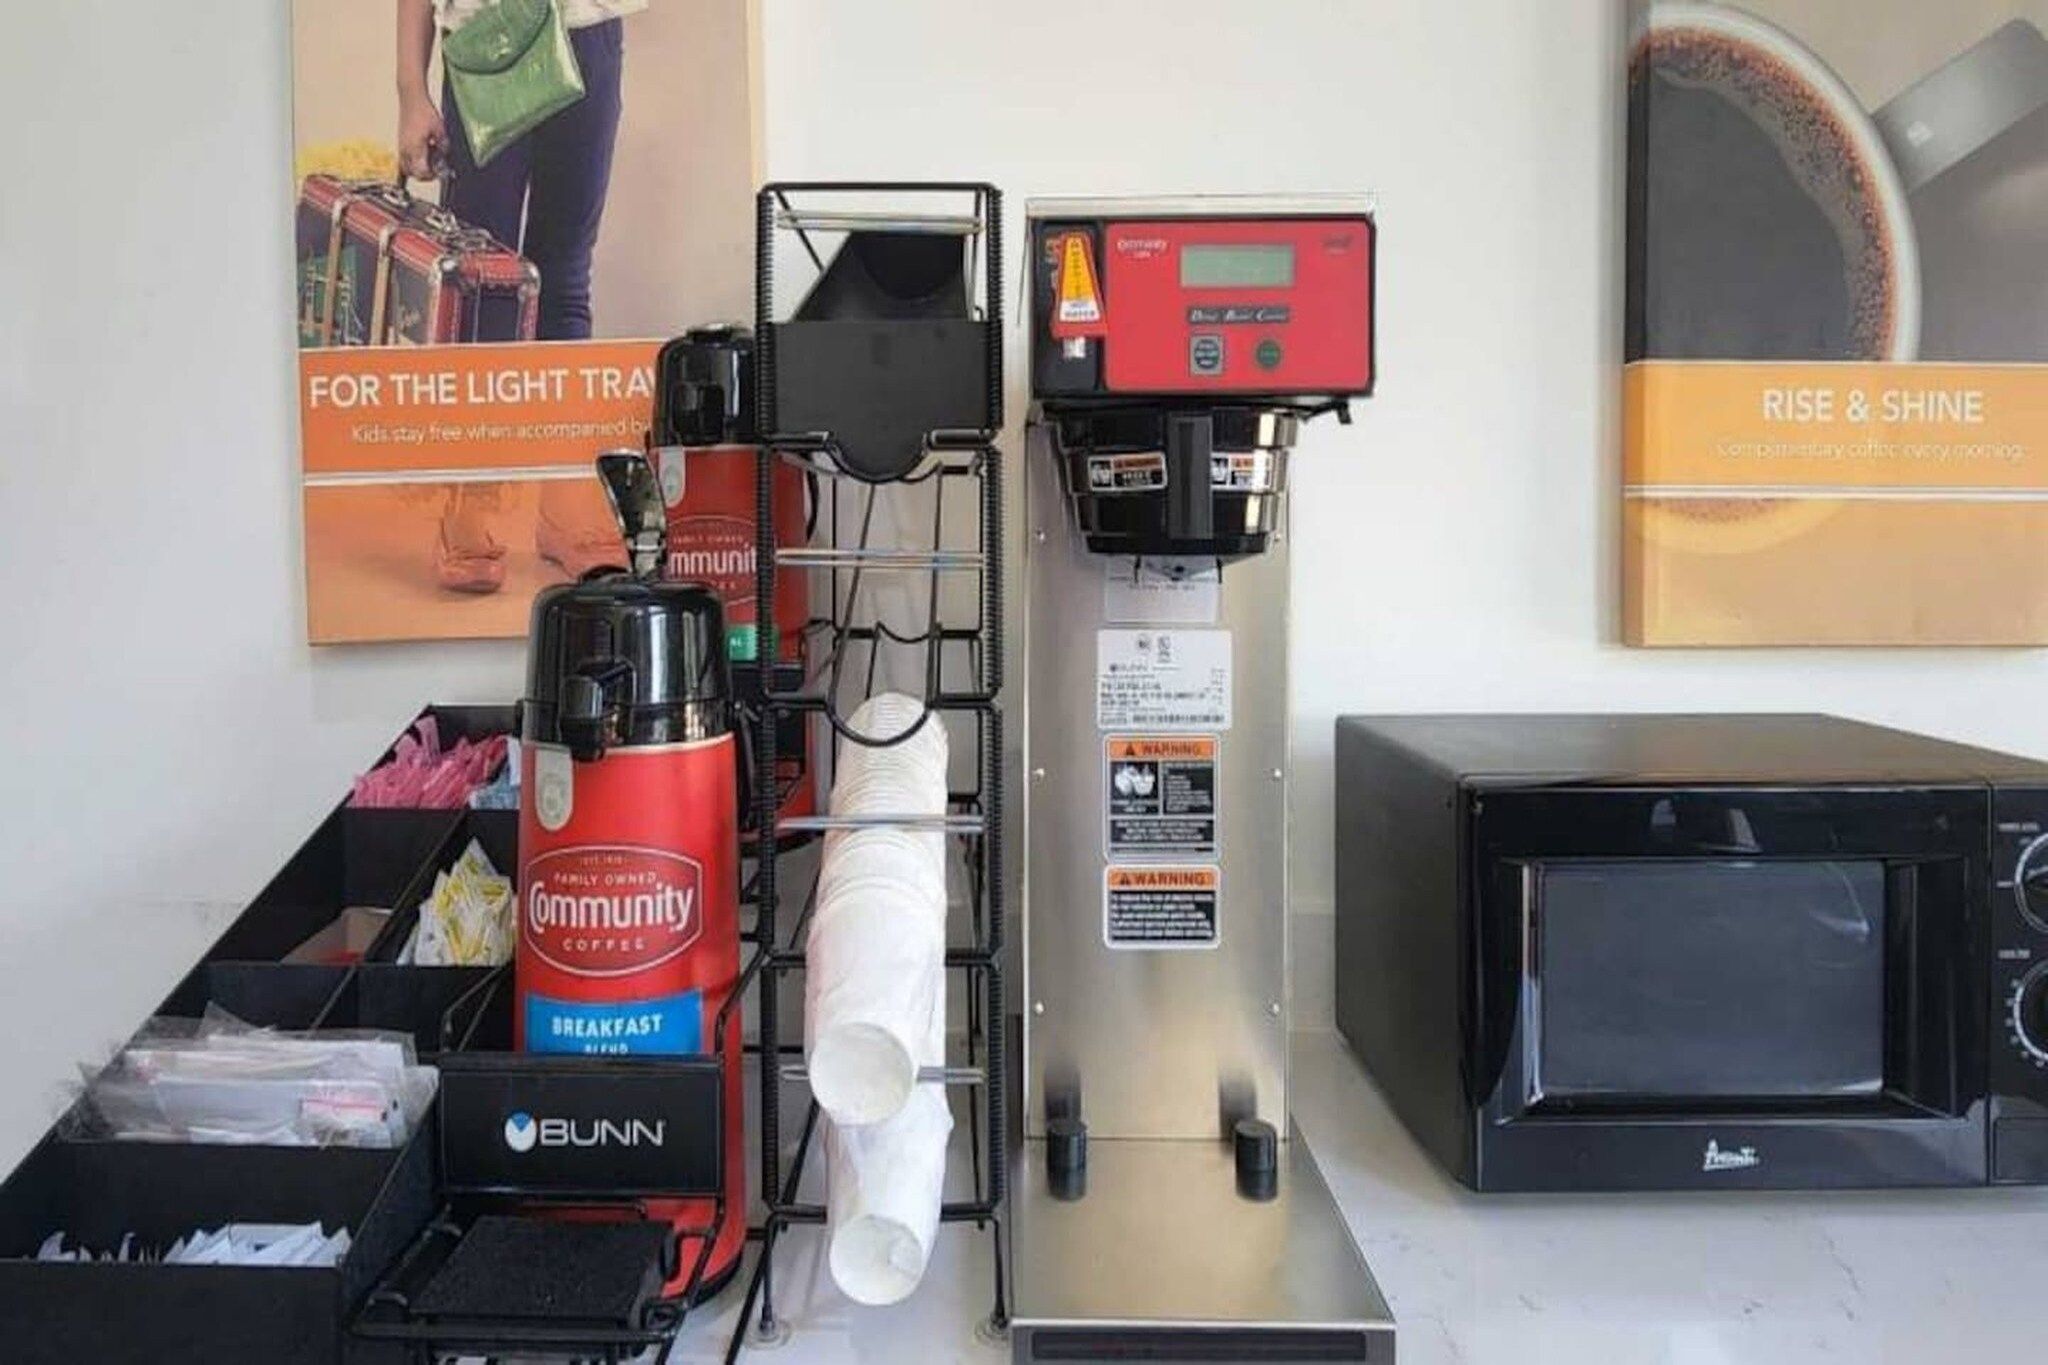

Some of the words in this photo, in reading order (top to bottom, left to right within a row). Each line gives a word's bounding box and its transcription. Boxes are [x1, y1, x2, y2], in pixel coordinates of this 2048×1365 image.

[310, 374, 381, 408] FOR
[389, 372, 458, 406] THE
[467, 369, 569, 404] LIGHT
[579, 366, 656, 400] TRAV
[1762, 388, 1834, 423] RISE
[1845, 389, 1870, 423] &
[1882, 390, 1986, 424] SHINE
[352, 424, 389, 443] Kids
[393, 427, 424, 447] stay
[429, 421, 462, 441] free
[465, 418, 513, 441] when
[516, 417, 626, 442] accompanied
[670, 542, 757, 575] mmunit
[1142, 742, 1202, 757] WARNING
[554, 873, 598, 887] FAMILY
[604, 871, 657, 887] OWNED
[1134, 871, 1207, 886] WARNING
[529, 880, 694, 934] Community
[562, 938, 646, 952] COFFEE
[552, 1013, 664, 1038] BREAKFAST
[540, 1118, 664, 1147] BUNN
